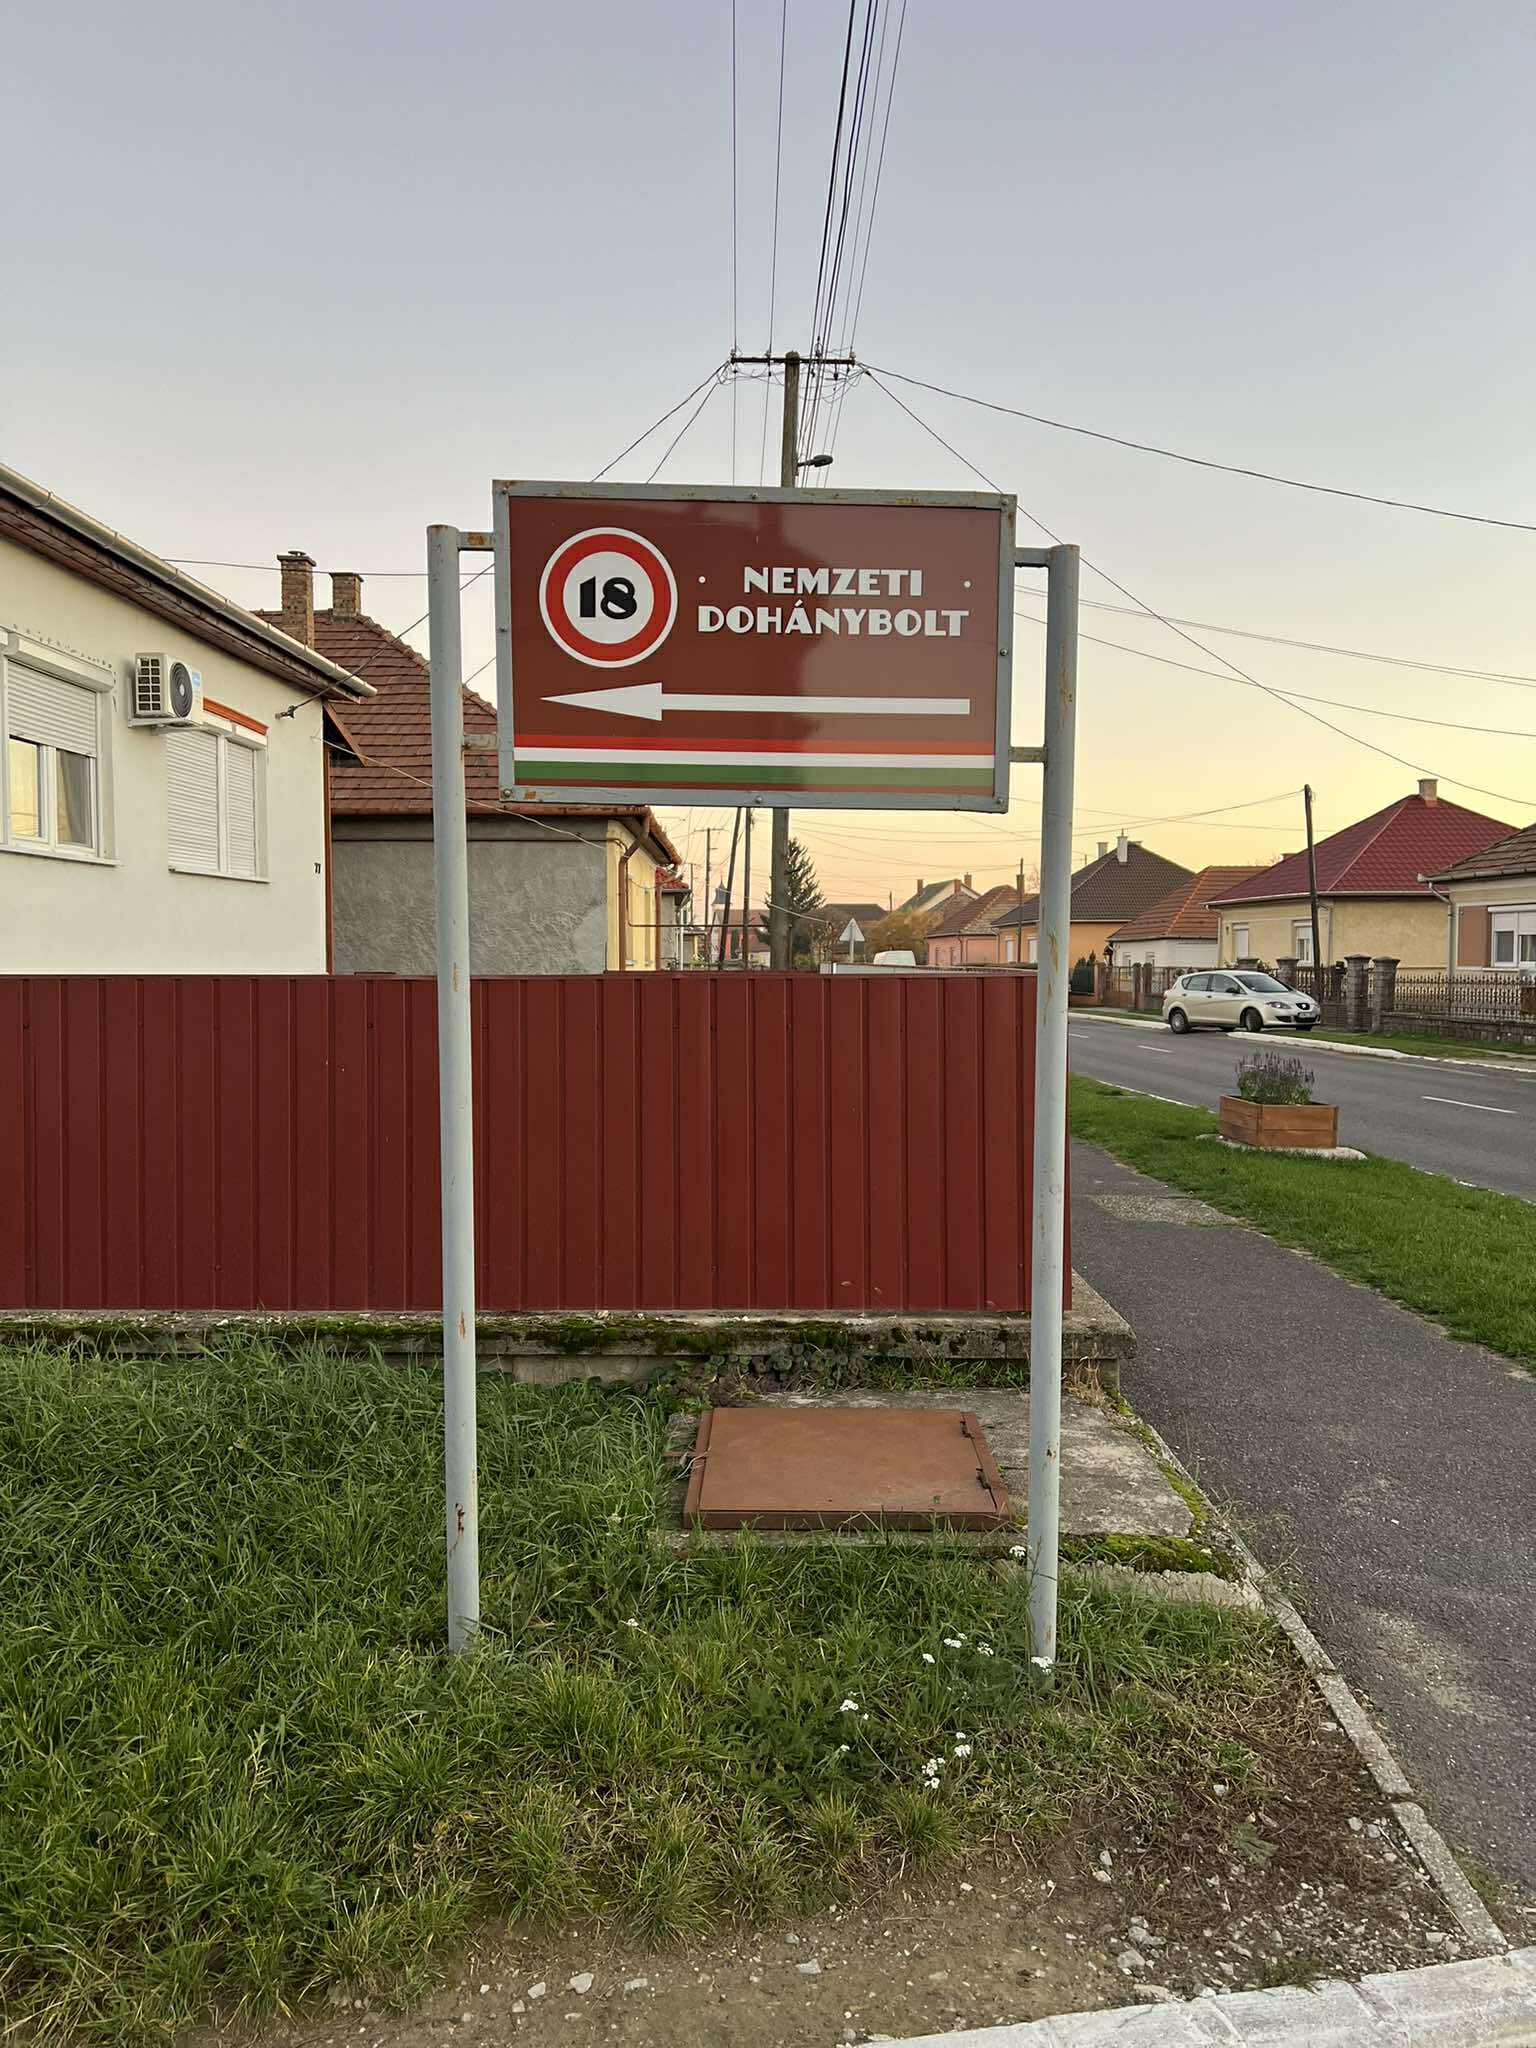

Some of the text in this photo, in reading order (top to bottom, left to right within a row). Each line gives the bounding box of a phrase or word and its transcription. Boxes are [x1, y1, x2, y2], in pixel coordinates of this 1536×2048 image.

[579, 575, 638, 620] 18
[743, 566, 922, 596] NEMZETI
[698, 600, 970, 637] DOHÁNYBOLT
